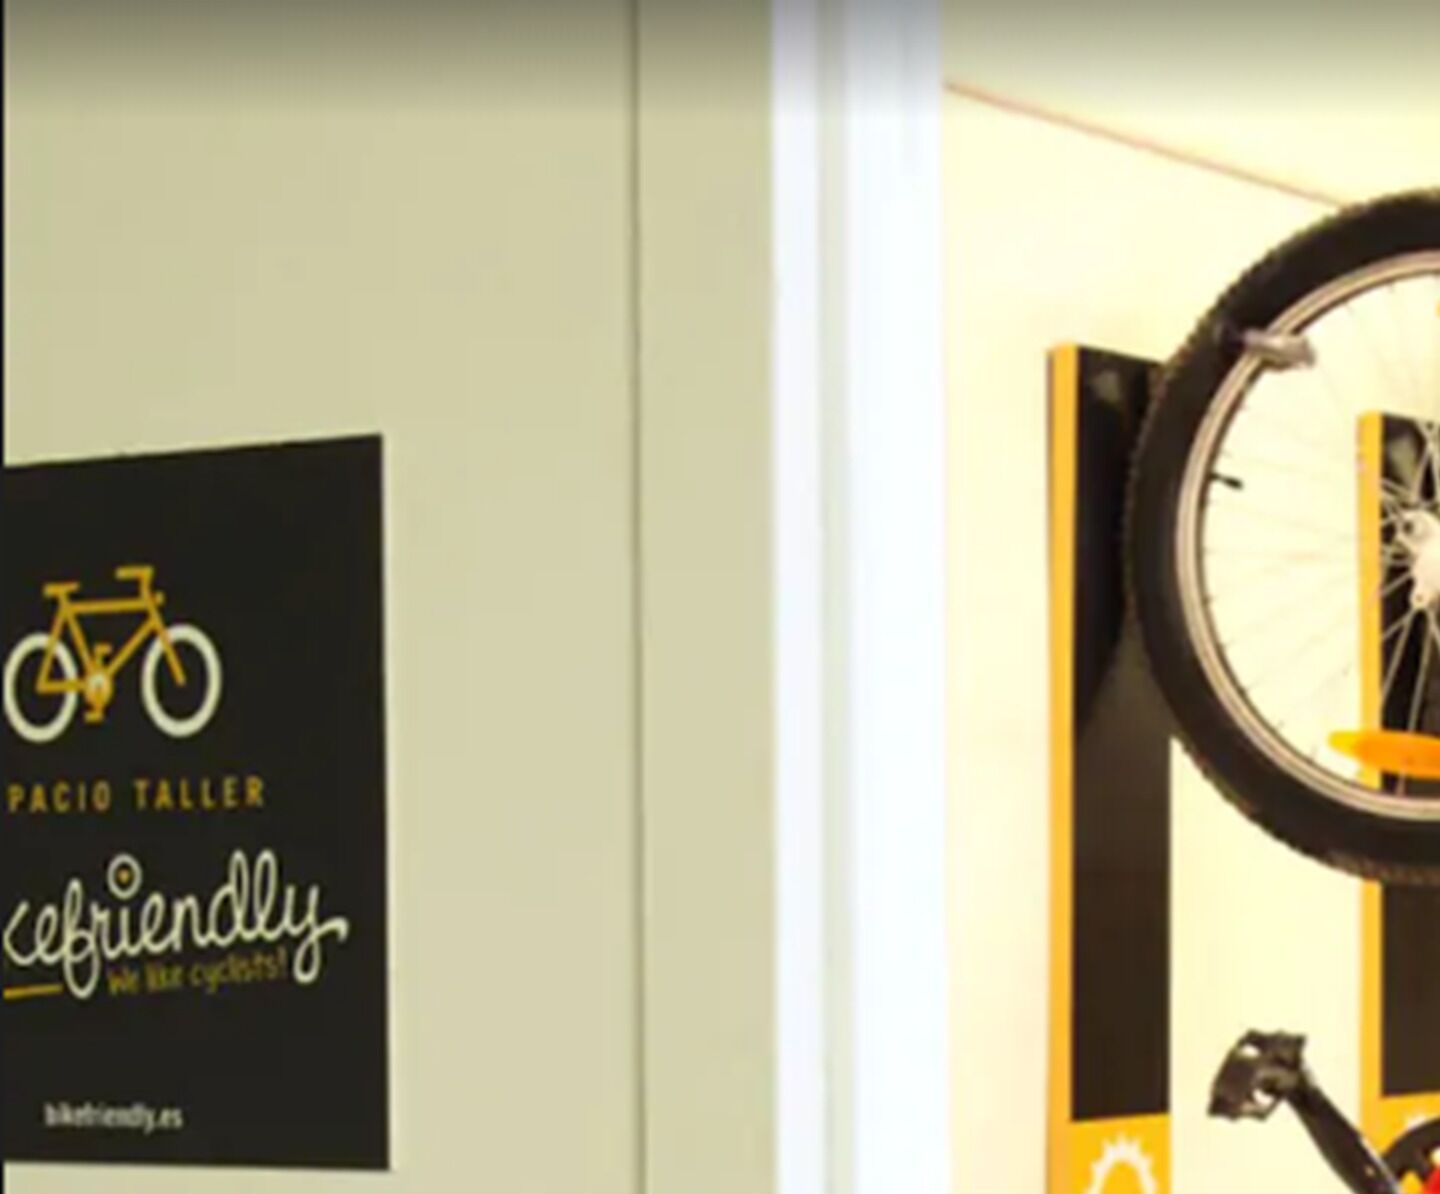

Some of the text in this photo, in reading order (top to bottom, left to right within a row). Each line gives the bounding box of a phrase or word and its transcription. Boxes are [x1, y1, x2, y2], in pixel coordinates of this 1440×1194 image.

[7, 775, 264, 814] PACIO TALLER
[44, 1101, 184, 1135] bikefriendly.es
